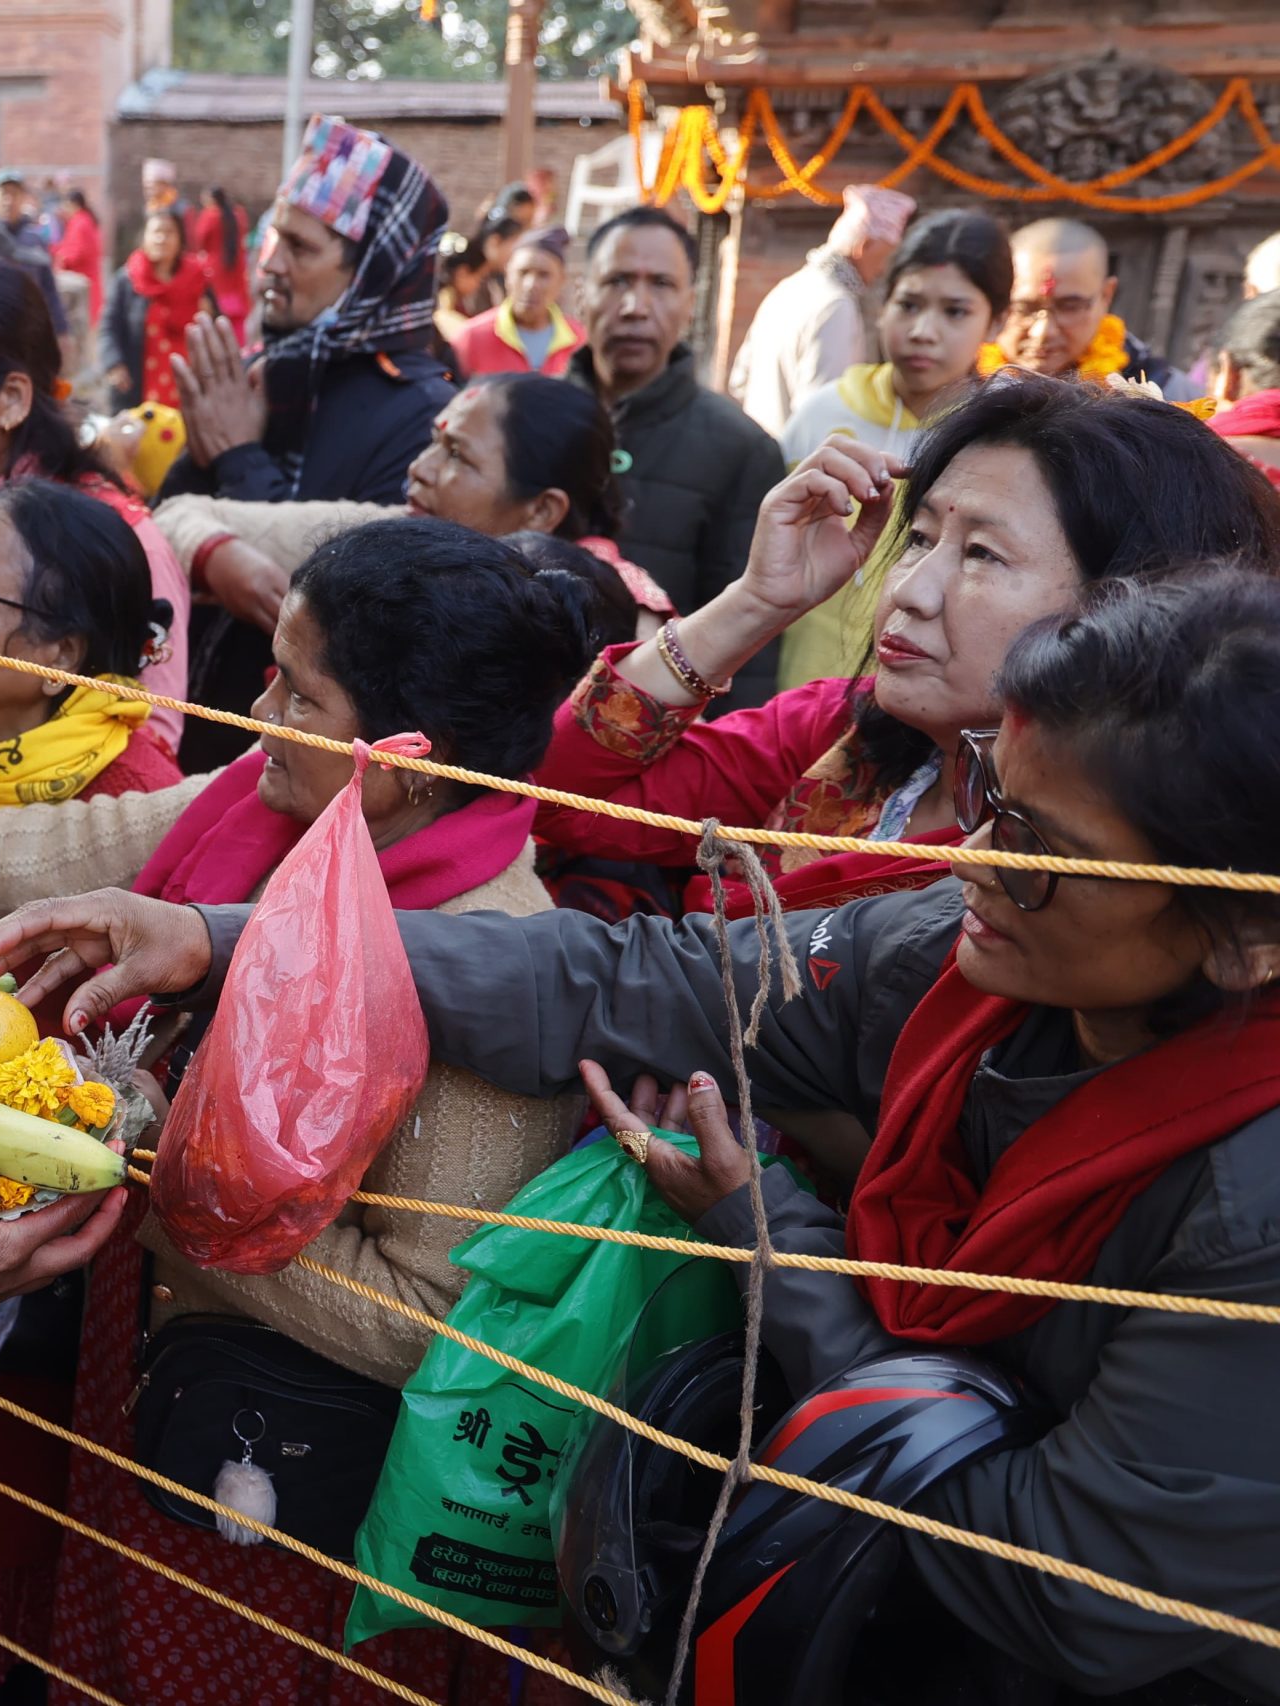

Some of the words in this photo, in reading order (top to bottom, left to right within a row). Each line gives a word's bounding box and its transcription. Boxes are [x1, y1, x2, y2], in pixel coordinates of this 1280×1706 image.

[453, 1408, 492, 1449] श्री
[495, 1421, 560, 1506] ड्रे
[431, 1545, 469, 1565] हरेक
[475, 1557, 533, 1577] स्कुलको
[486, 1581, 516, 1595] तथा
